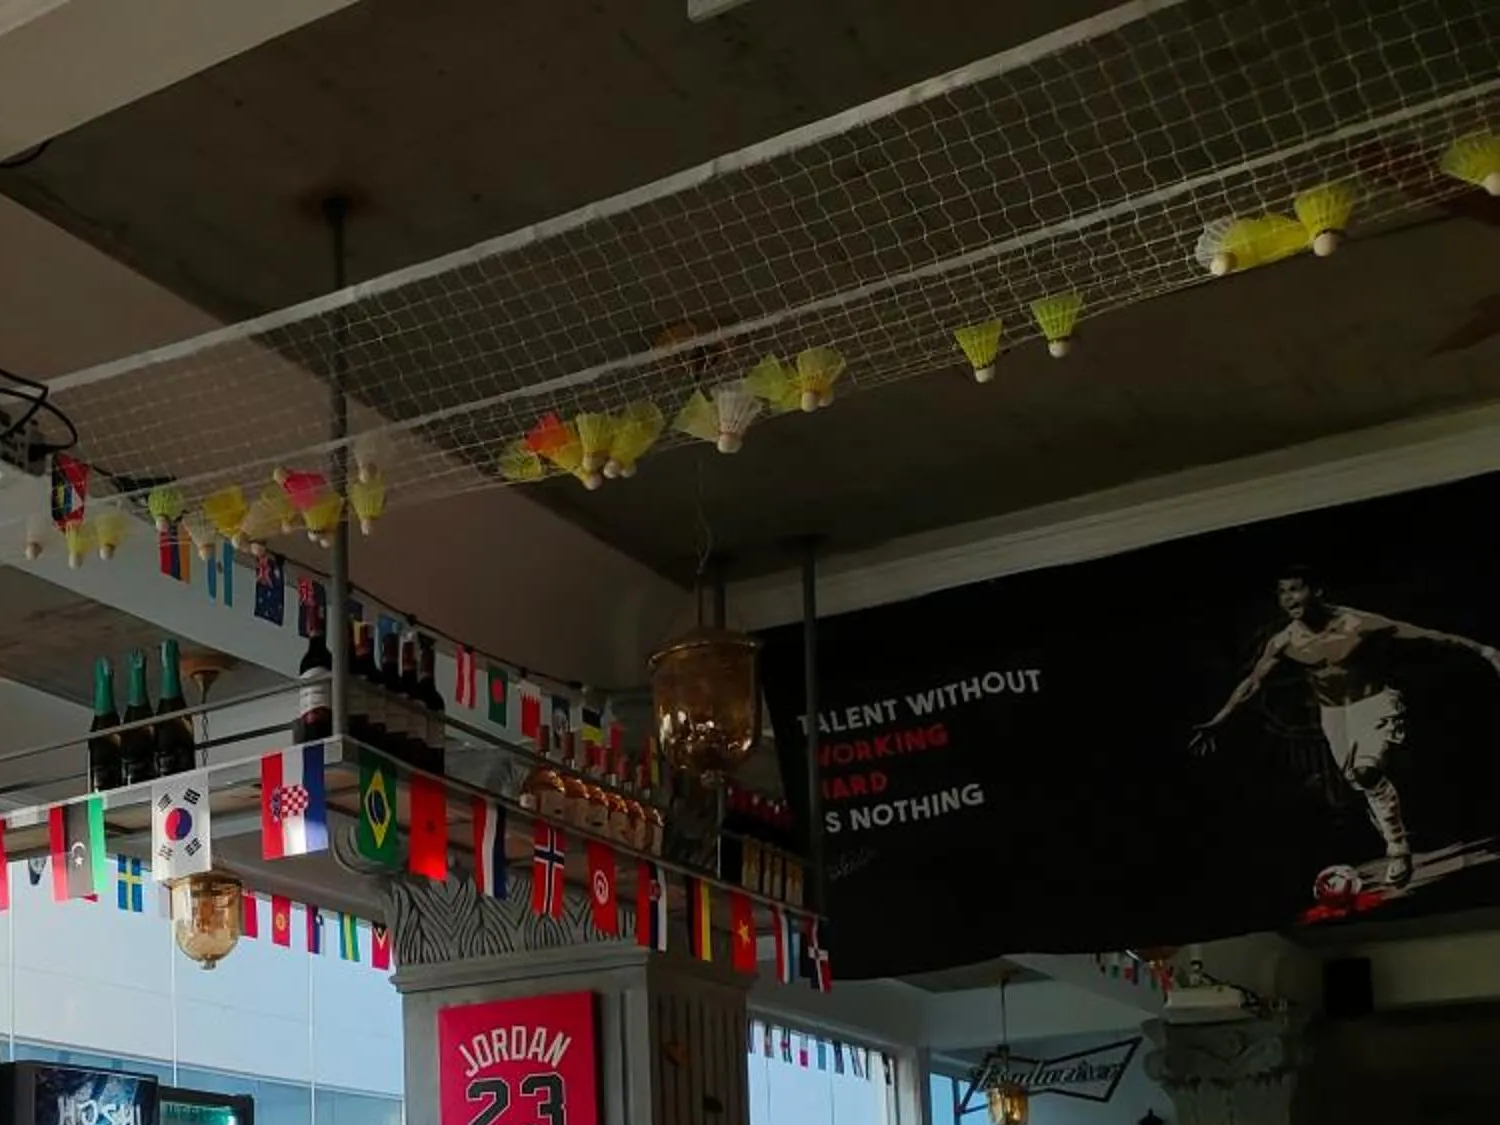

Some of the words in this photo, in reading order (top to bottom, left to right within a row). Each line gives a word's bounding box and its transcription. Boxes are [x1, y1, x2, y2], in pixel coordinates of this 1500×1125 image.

[905, 668, 1043, 717] WITHOUT
[825, 810, 843, 835] S
[849, 783, 986, 833] NOTHING
[458, 1024, 573, 1078] JORDAN
